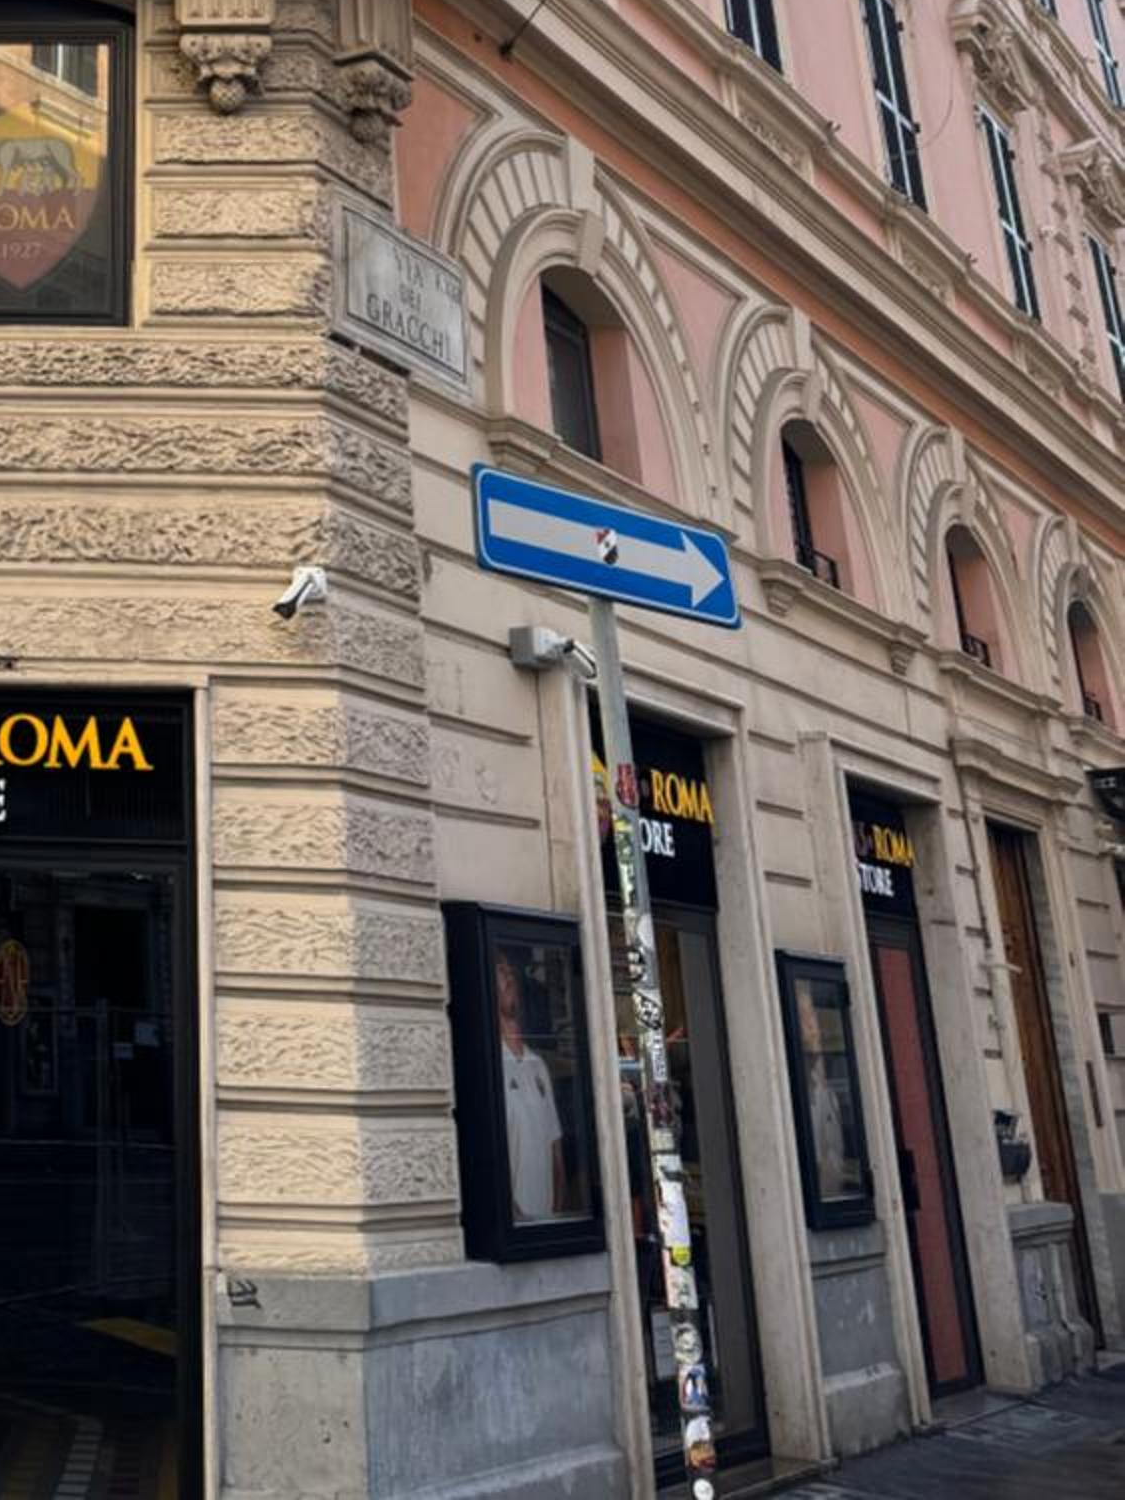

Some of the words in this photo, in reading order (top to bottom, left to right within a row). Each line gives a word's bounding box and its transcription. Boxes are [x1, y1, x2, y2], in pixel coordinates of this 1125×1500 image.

[2, 241, 43, 261] 1927
[393, 245, 425, 290] VIA
[365, 292, 452, 363] GRACCHI
[651, 767, 715, 825] ROMA
[638, 816, 676, 858] ORE
[871, 823, 915, 868] ROMA
